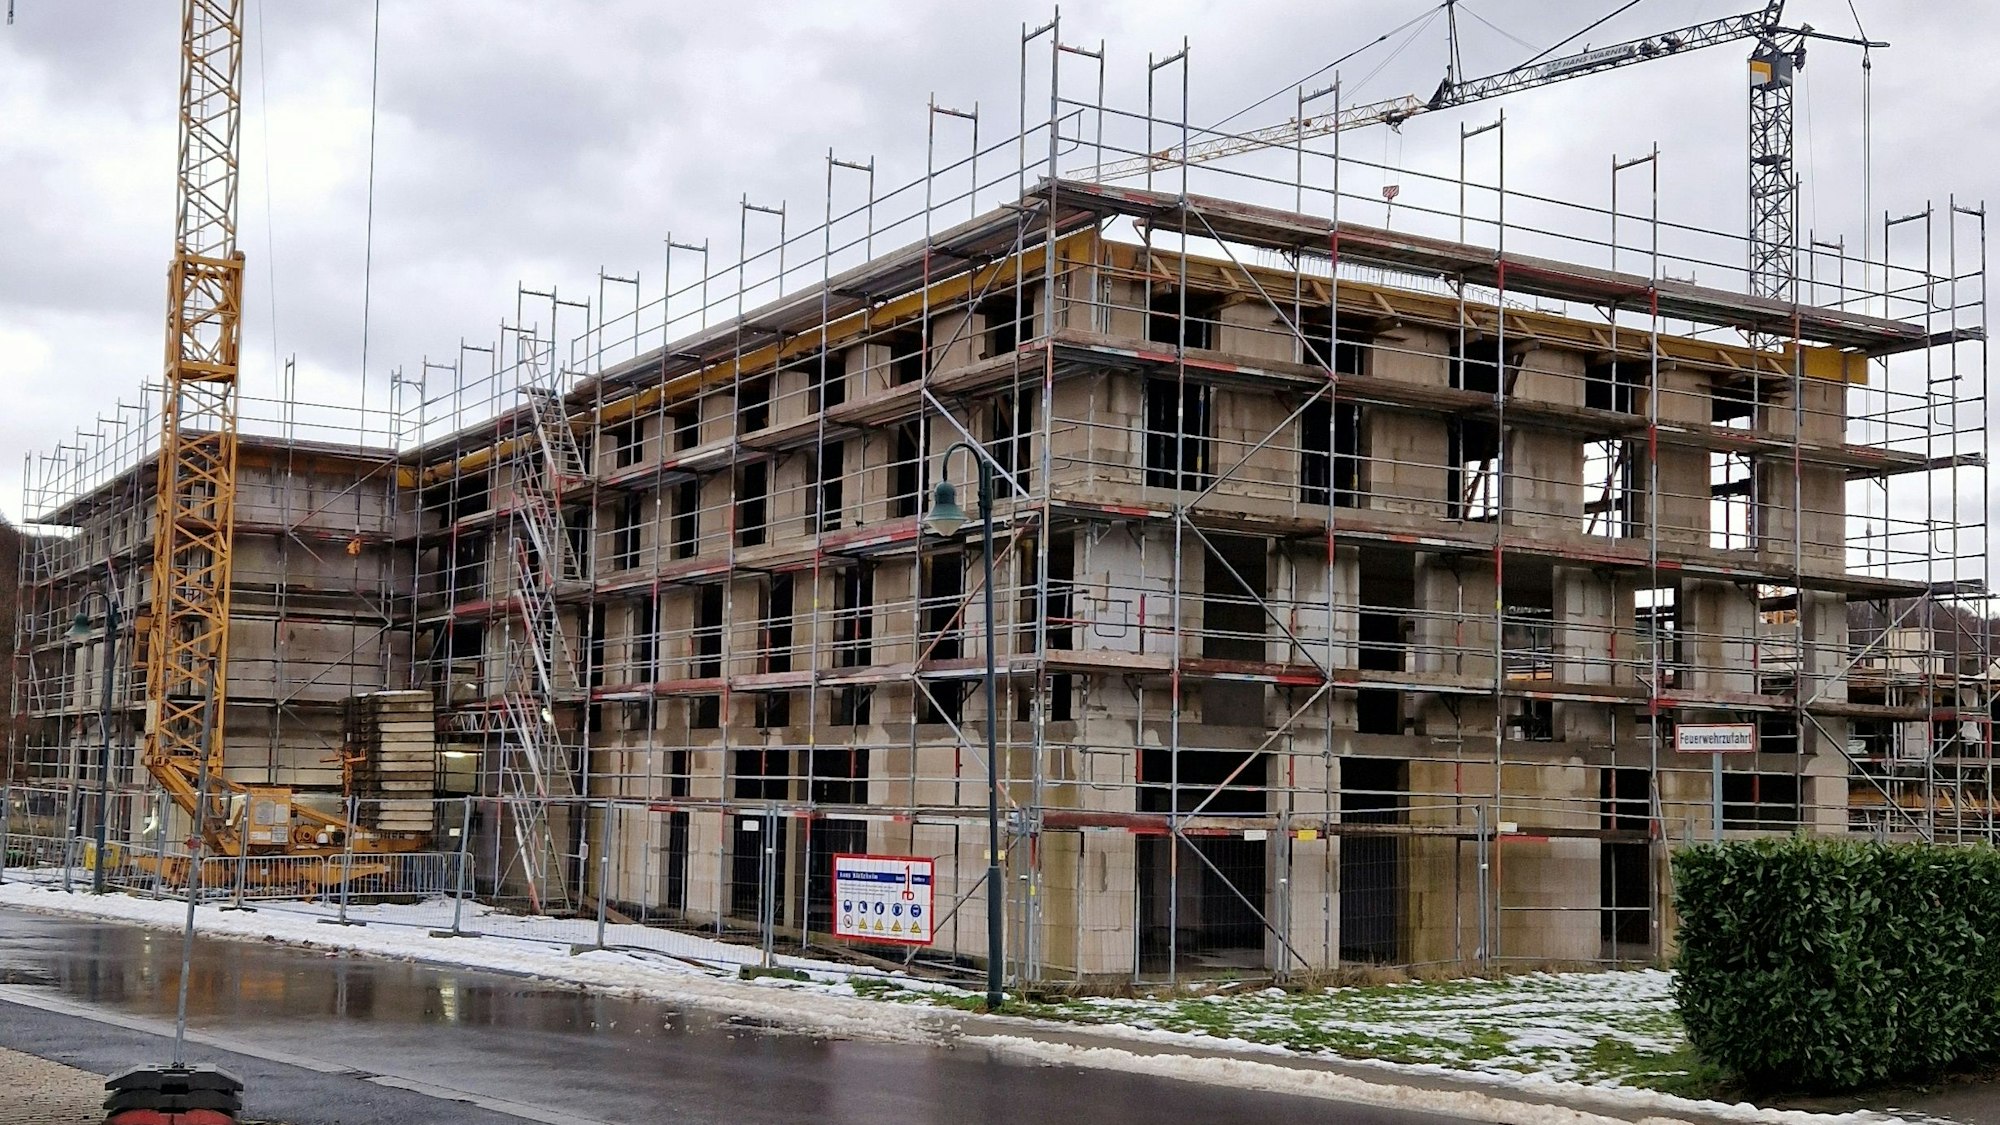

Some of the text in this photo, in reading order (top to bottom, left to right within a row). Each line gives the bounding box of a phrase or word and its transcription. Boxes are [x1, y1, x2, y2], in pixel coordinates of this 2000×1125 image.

[1562, 46, 1630, 68] HANS WARNER
[1680, 732, 1752, 744] Feuerwehrzufahrt
